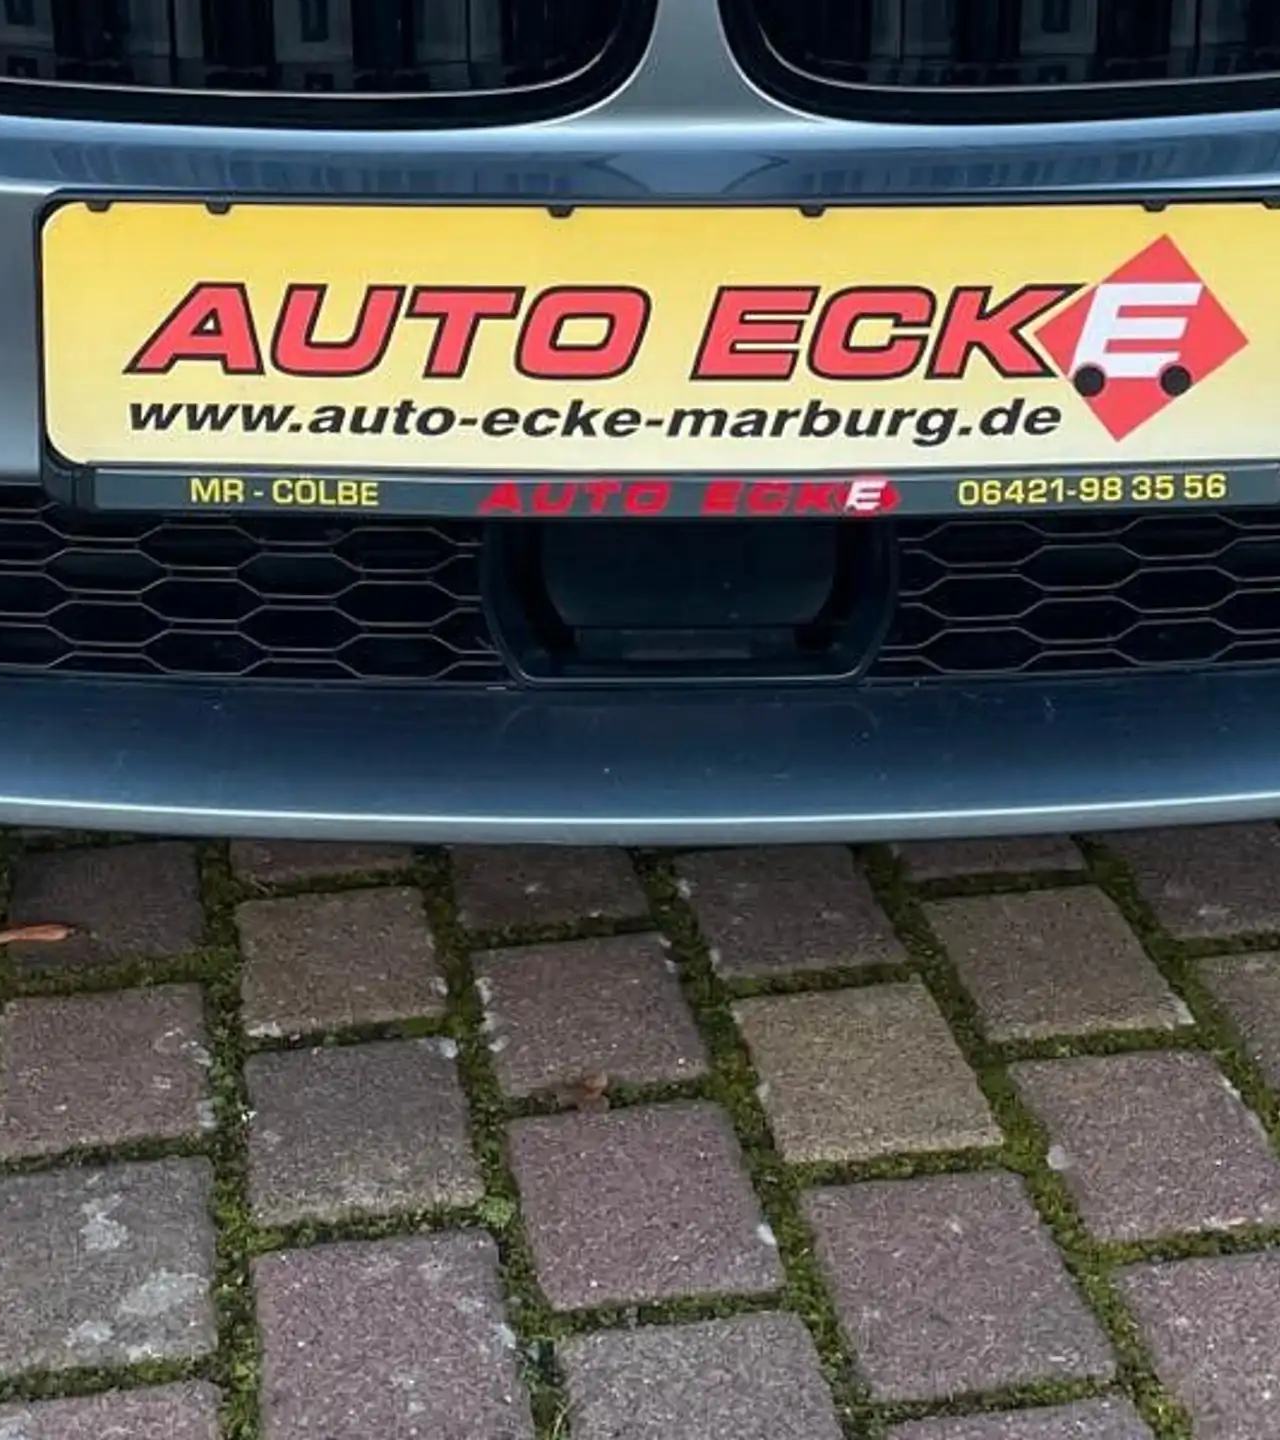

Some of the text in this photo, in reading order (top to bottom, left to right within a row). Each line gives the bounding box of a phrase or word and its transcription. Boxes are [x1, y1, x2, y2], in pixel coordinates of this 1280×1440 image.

[122, 280, 1205, 382] AUTO ECKE
[128, 397, 1063, 447] www.auto-ecke-marburg.de
[190, 478, 246, 504] MR
[273, 474, 380, 508] CÖLBE
[477, 479, 888, 517] AUTO ECKE
[957, 473, 1228, 506] 06421-98 35 56
